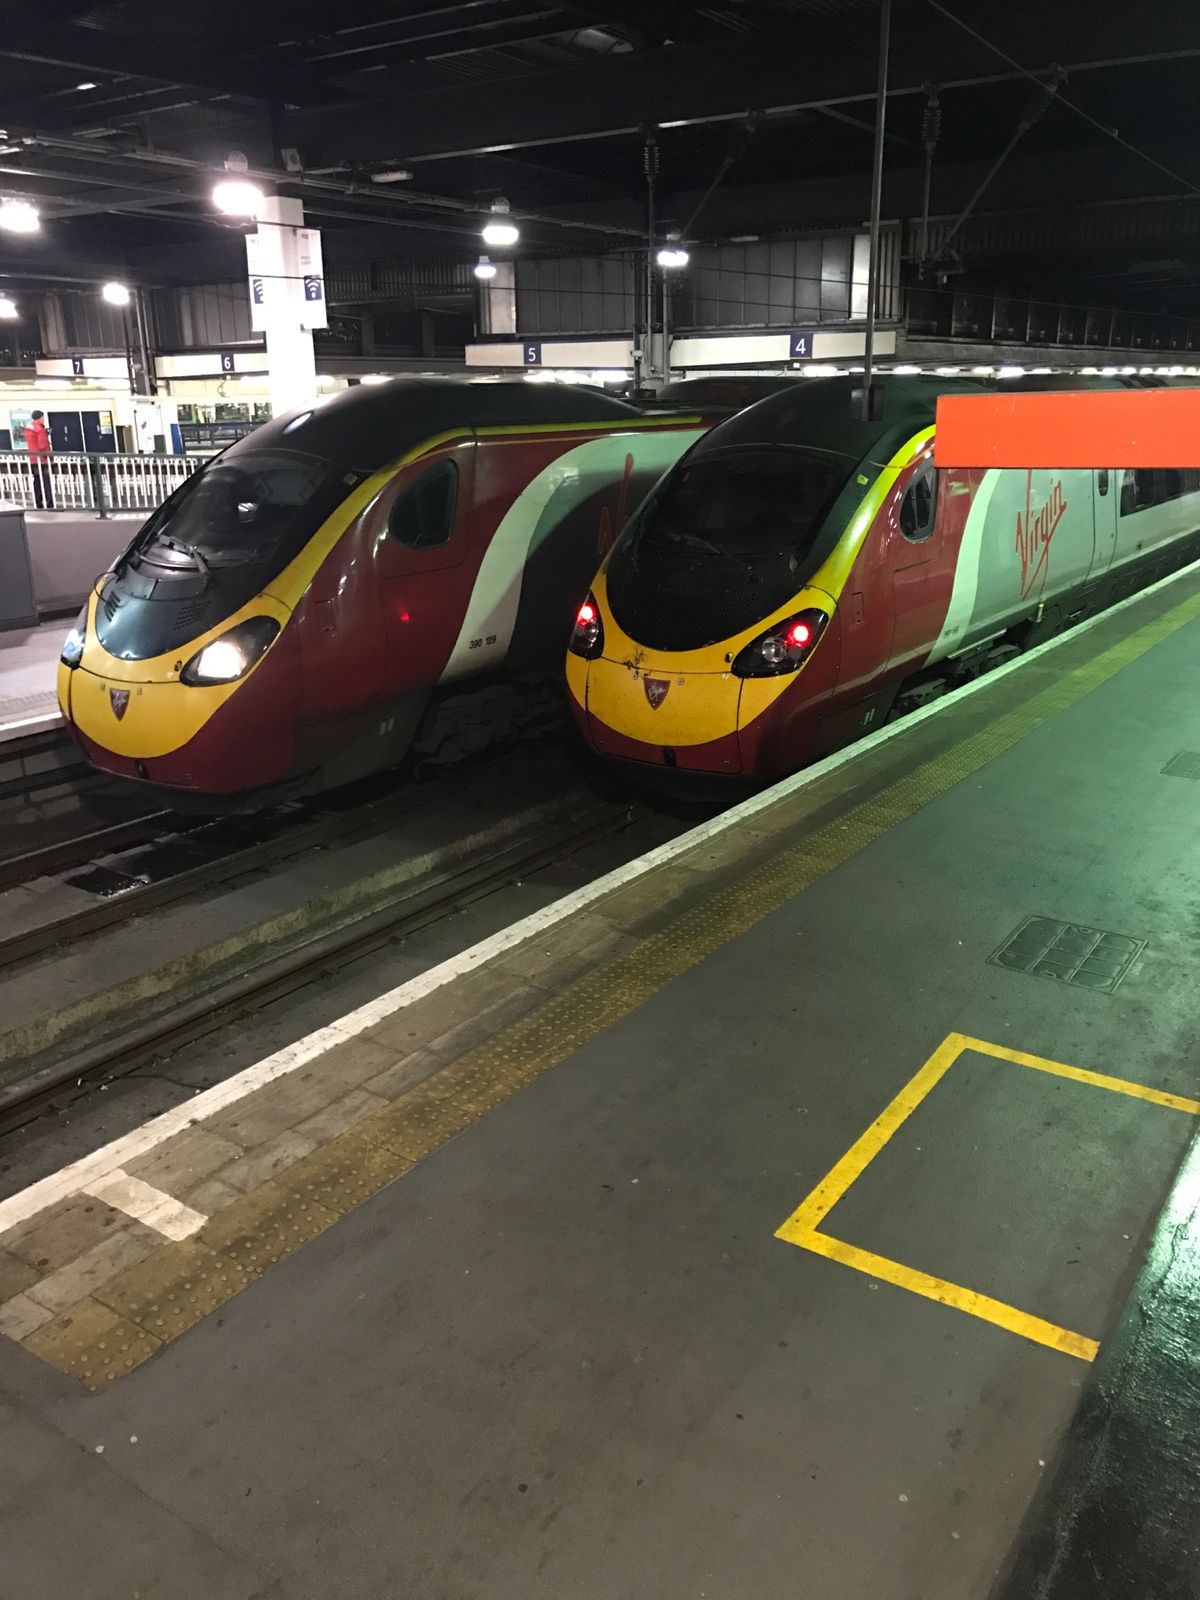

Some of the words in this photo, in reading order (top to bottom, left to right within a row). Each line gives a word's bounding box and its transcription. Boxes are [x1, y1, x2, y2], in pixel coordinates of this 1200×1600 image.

[795, 338, 807, 355] 4
[528, 347, 536, 362] 5
[74, 361, 80, 373] 7
[224, 356, 231, 370] 6
[1015, 468, 1067, 601] Virgin
